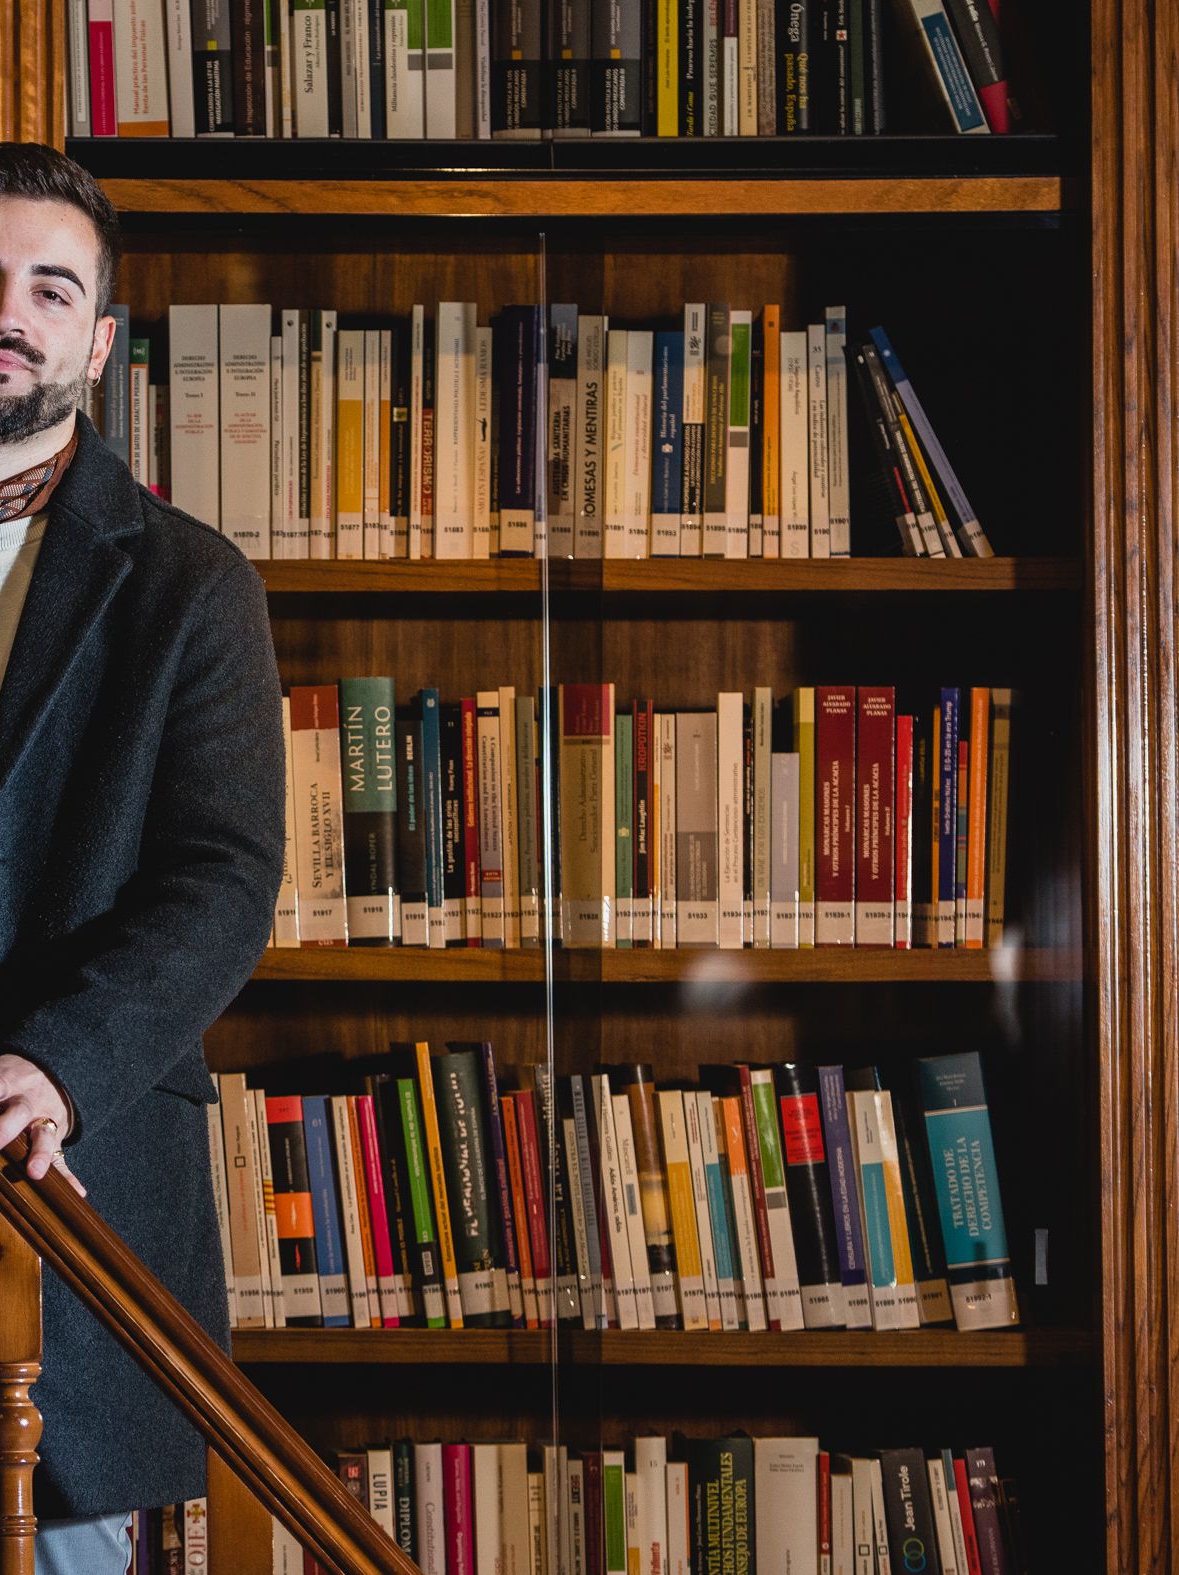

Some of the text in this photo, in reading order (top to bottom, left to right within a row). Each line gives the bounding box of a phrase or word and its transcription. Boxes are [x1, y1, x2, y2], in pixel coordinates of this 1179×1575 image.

[303, 15, 313, 47] Franco
[787, 3, 803, 42] Ónega
[130, 54, 139, 62] del
[131, 65, 139, 89] práctico
[140, 72, 148, 82] las
[303, 59, 314, 93] Salazar
[140, 85, 148, 93] de
[783, 54, 796, 130] pasado, España
[798, 52, 809, 109] Qué nos ha
[131, 91, 139, 113] Manual
[479, 371, 487, 411] LEDESMA
[552, 411, 561, 448] SANITARIA
[585, 381, 597, 444] MENTIRAS
[422, 414, 432, 494] TERRORISMO
[562, 492, 568, 500] EN
[347, 705, 364, 791] MARTÍN
[374, 705, 391, 790] LUTERO
[637, 712, 646, 770] KROPOTKIN
[322, 791, 331, 815] XVII
[408, 794, 414, 802] de
[832, 787, 838, 796] LA
[832, 798, 838, 807] DE
[872, 801, 879, 810] DE
[873, 790, 879, 799] LA
[310, 782, 321, 888] SEVILLA BARROCA
[323, 817, 332, 851] SIGLO
[822, 816, 830, 855] MONARCAS
[323, 853, 332, 868] EL
[943, 1148, 964, 1227] TRATADO DE
[956, 1136, 979, 1236] DERECHO DE LA
[970, 1139, 992, 1230] COMPETENCIA
[372, 1473, 386, 1511] LUPIA
[722, 1452, 733, 1548] FUNDAMENTALES
[736, 1479, 746, 1520] EUROPA
[897, 1465, 914, 1530] Jean Tirole
[707, 1479, 719, 1546] MULTINIVEL
[735, 1522, 746, 1538] DE
